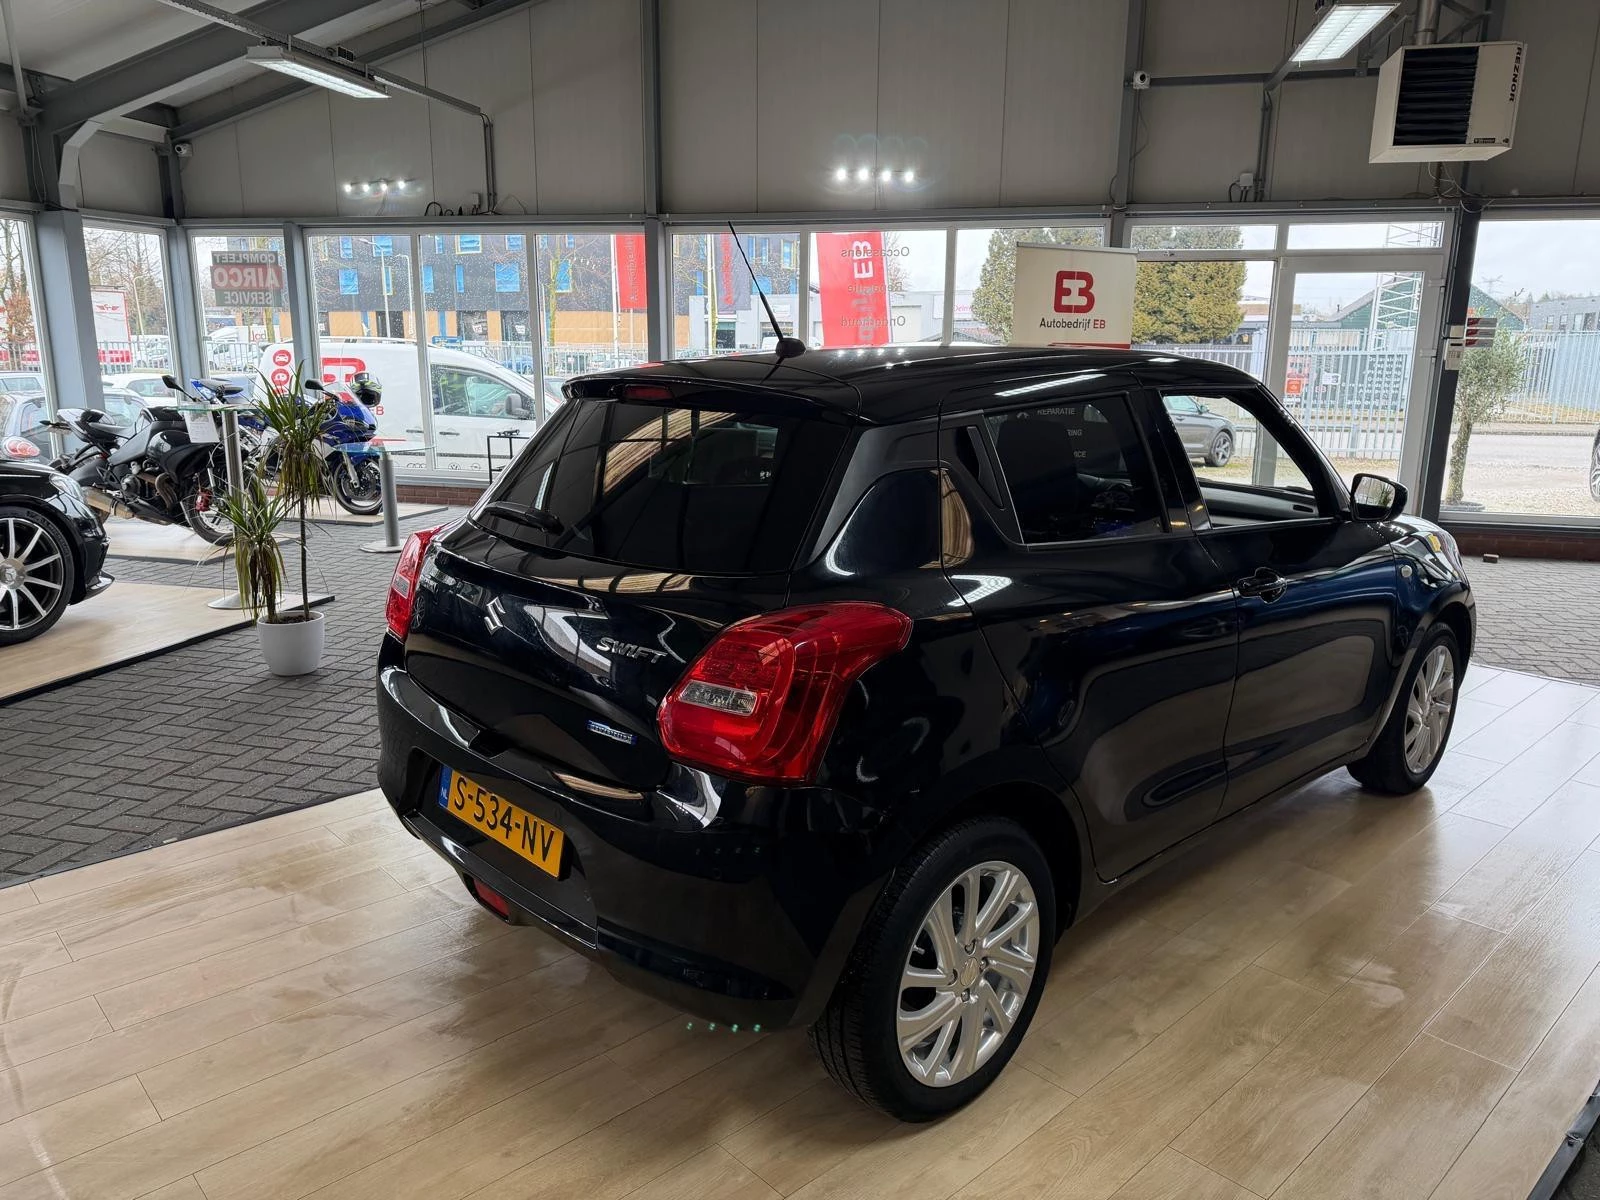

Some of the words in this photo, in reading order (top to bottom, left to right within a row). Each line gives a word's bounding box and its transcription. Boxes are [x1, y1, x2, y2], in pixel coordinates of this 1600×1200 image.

[1509, 47, 1522, 102] REZNOR
[1039, 317, 1092, 331] Autobedrijf
[1093, 319, 1106, 329] EB
[596, 636, 668, 664] SWIFT
[441, 787, 448, 799] NL
[454, 776, 555, 862] S-534-NV
